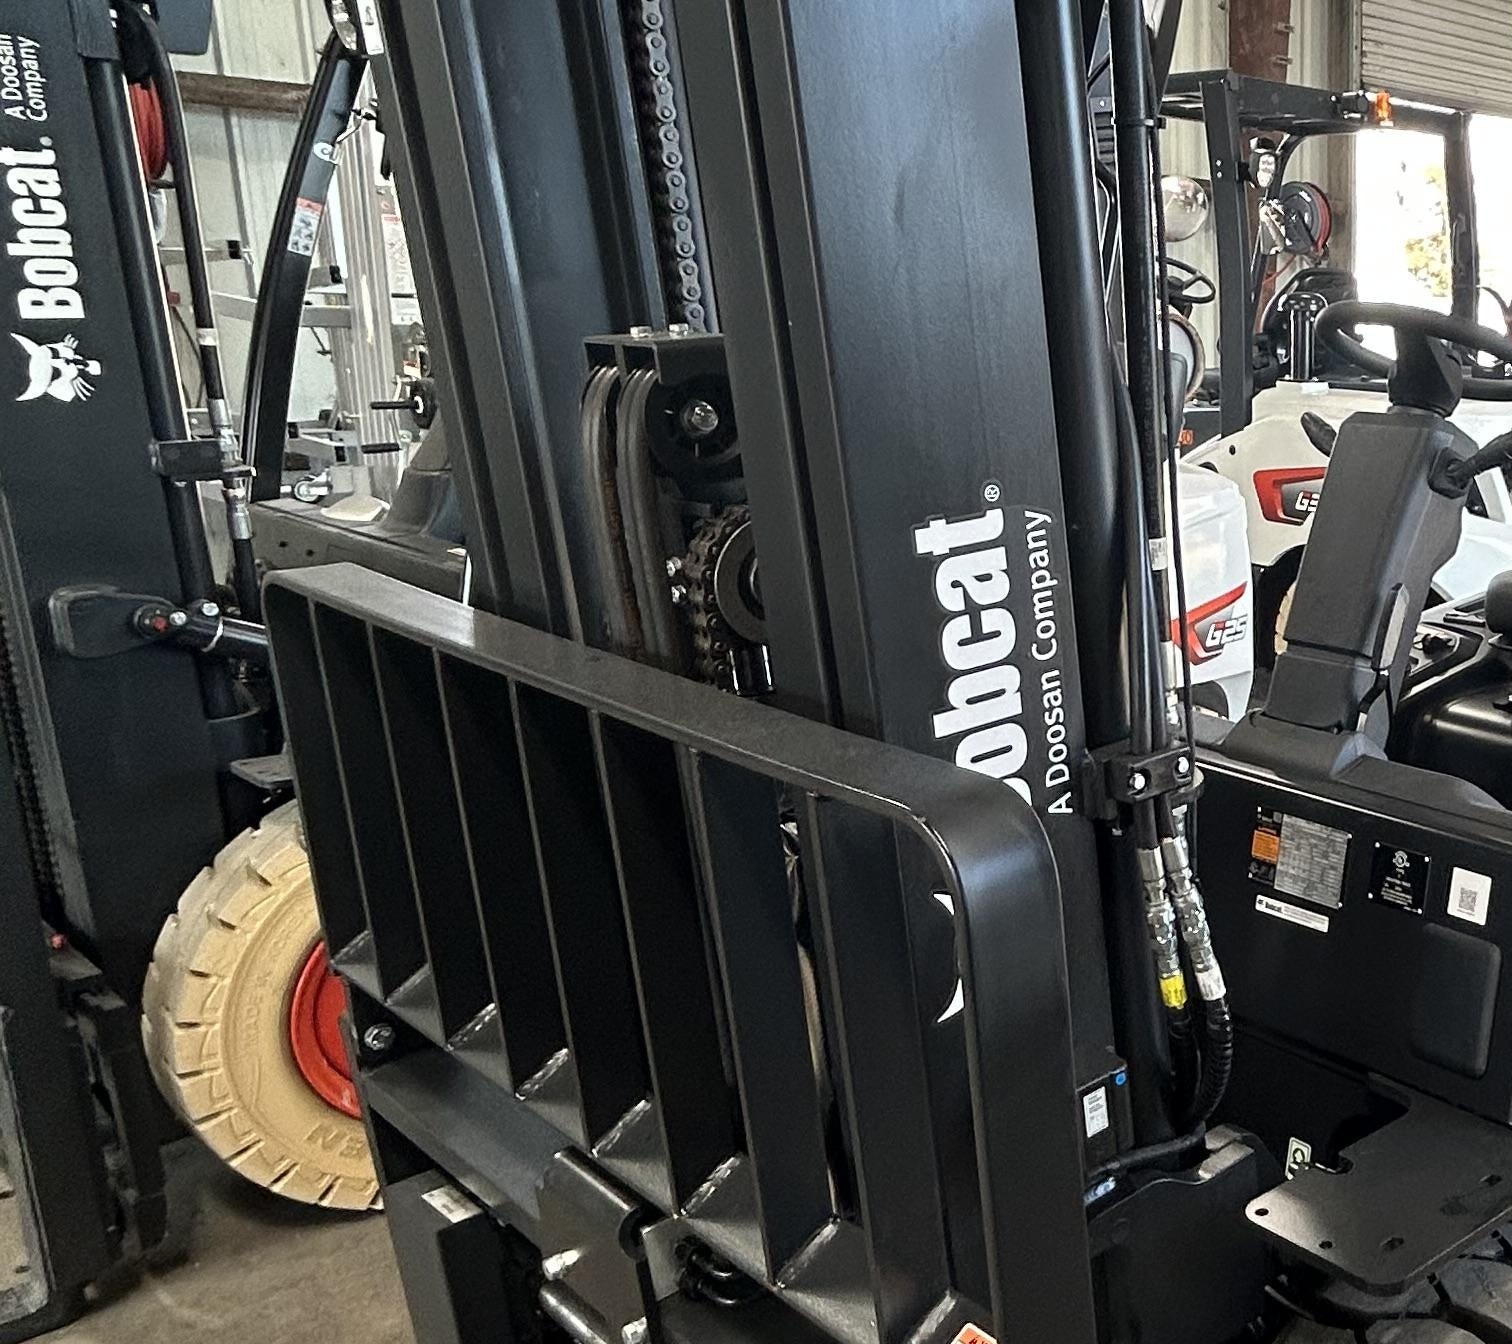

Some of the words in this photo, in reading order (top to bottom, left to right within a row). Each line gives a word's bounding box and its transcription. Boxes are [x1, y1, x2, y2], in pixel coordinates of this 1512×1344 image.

[0, 33, 23, 101] Doosan
[17, 36, 48, 122] Company
[4, 105, 27, 120] A
[0, 146, 85, 319] Bobcat
[1295, 490, 1321, 512] G3
[1024, 509, 1058, 662] Company
[914, 508, 1032, 806] obcat
[1205, 613, 1248, 647] G25
[1041, 669, 1072, 788] Doosan
[1047, 791, 1074, 815] A
